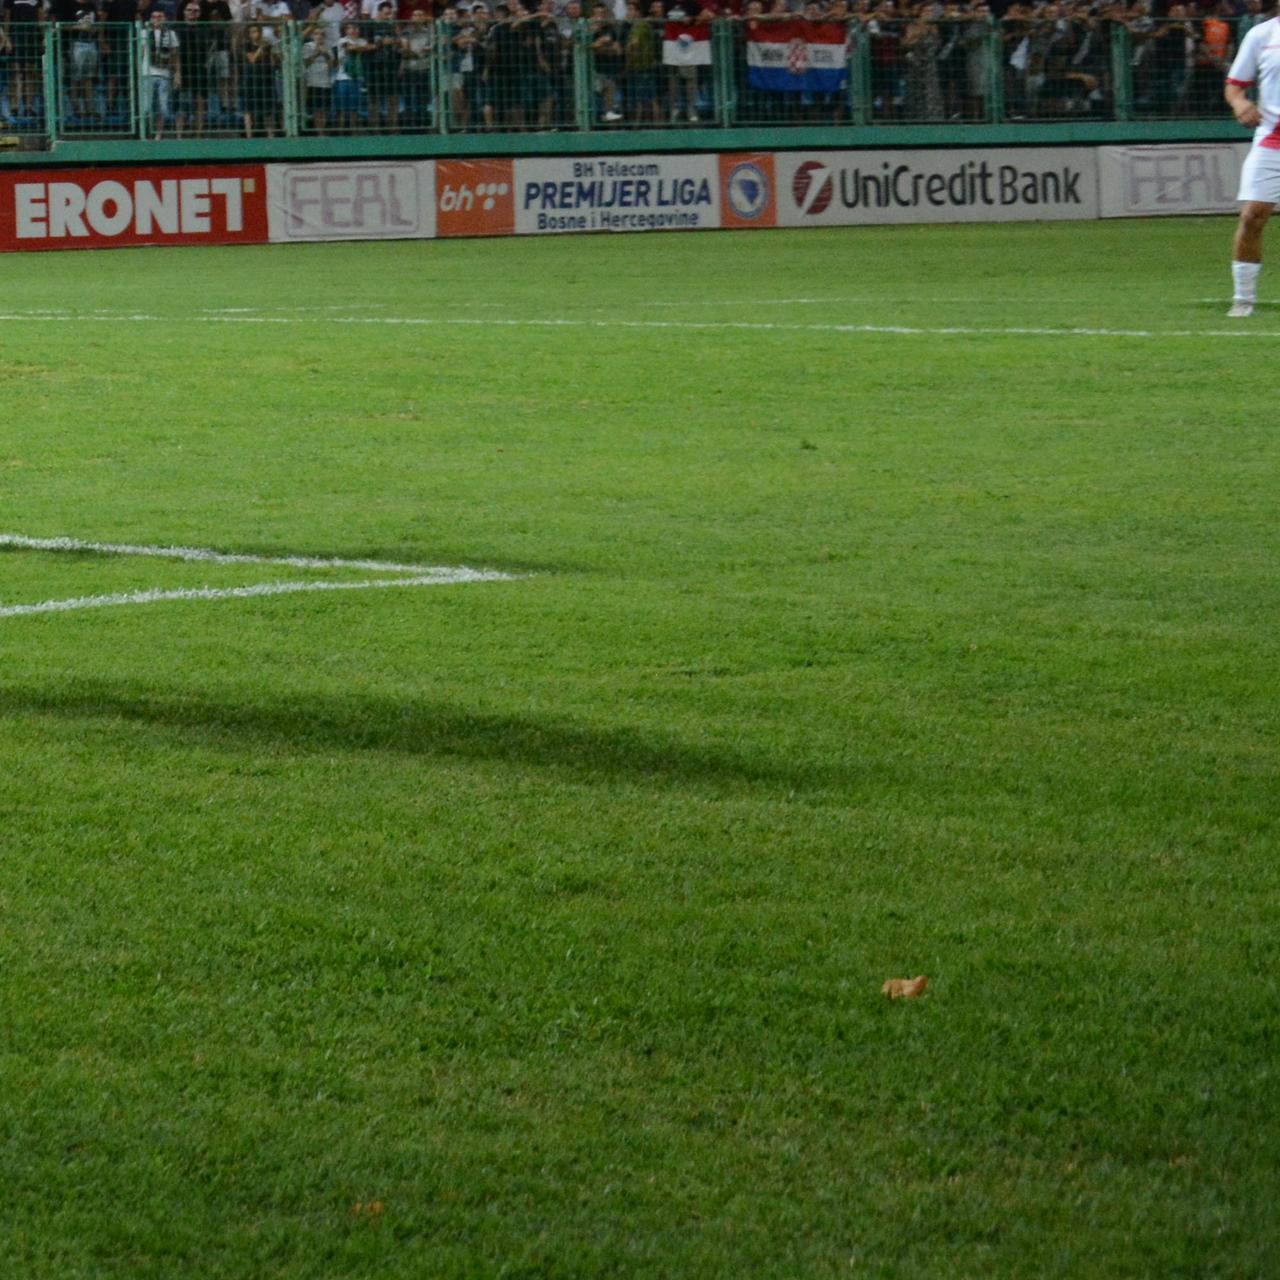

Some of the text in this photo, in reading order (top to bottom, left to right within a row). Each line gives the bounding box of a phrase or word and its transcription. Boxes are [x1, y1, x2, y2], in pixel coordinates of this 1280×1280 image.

[599, 161, 660, 177] Telecom
[14, 177, 244, 239] ERONET
[289, 174, 414, 229] FEAL
[440, 183, 474, 212] bh
[524, 178, 712, 210] PREMIJER LIGA
[537, 213, 586, 230] Bosne
